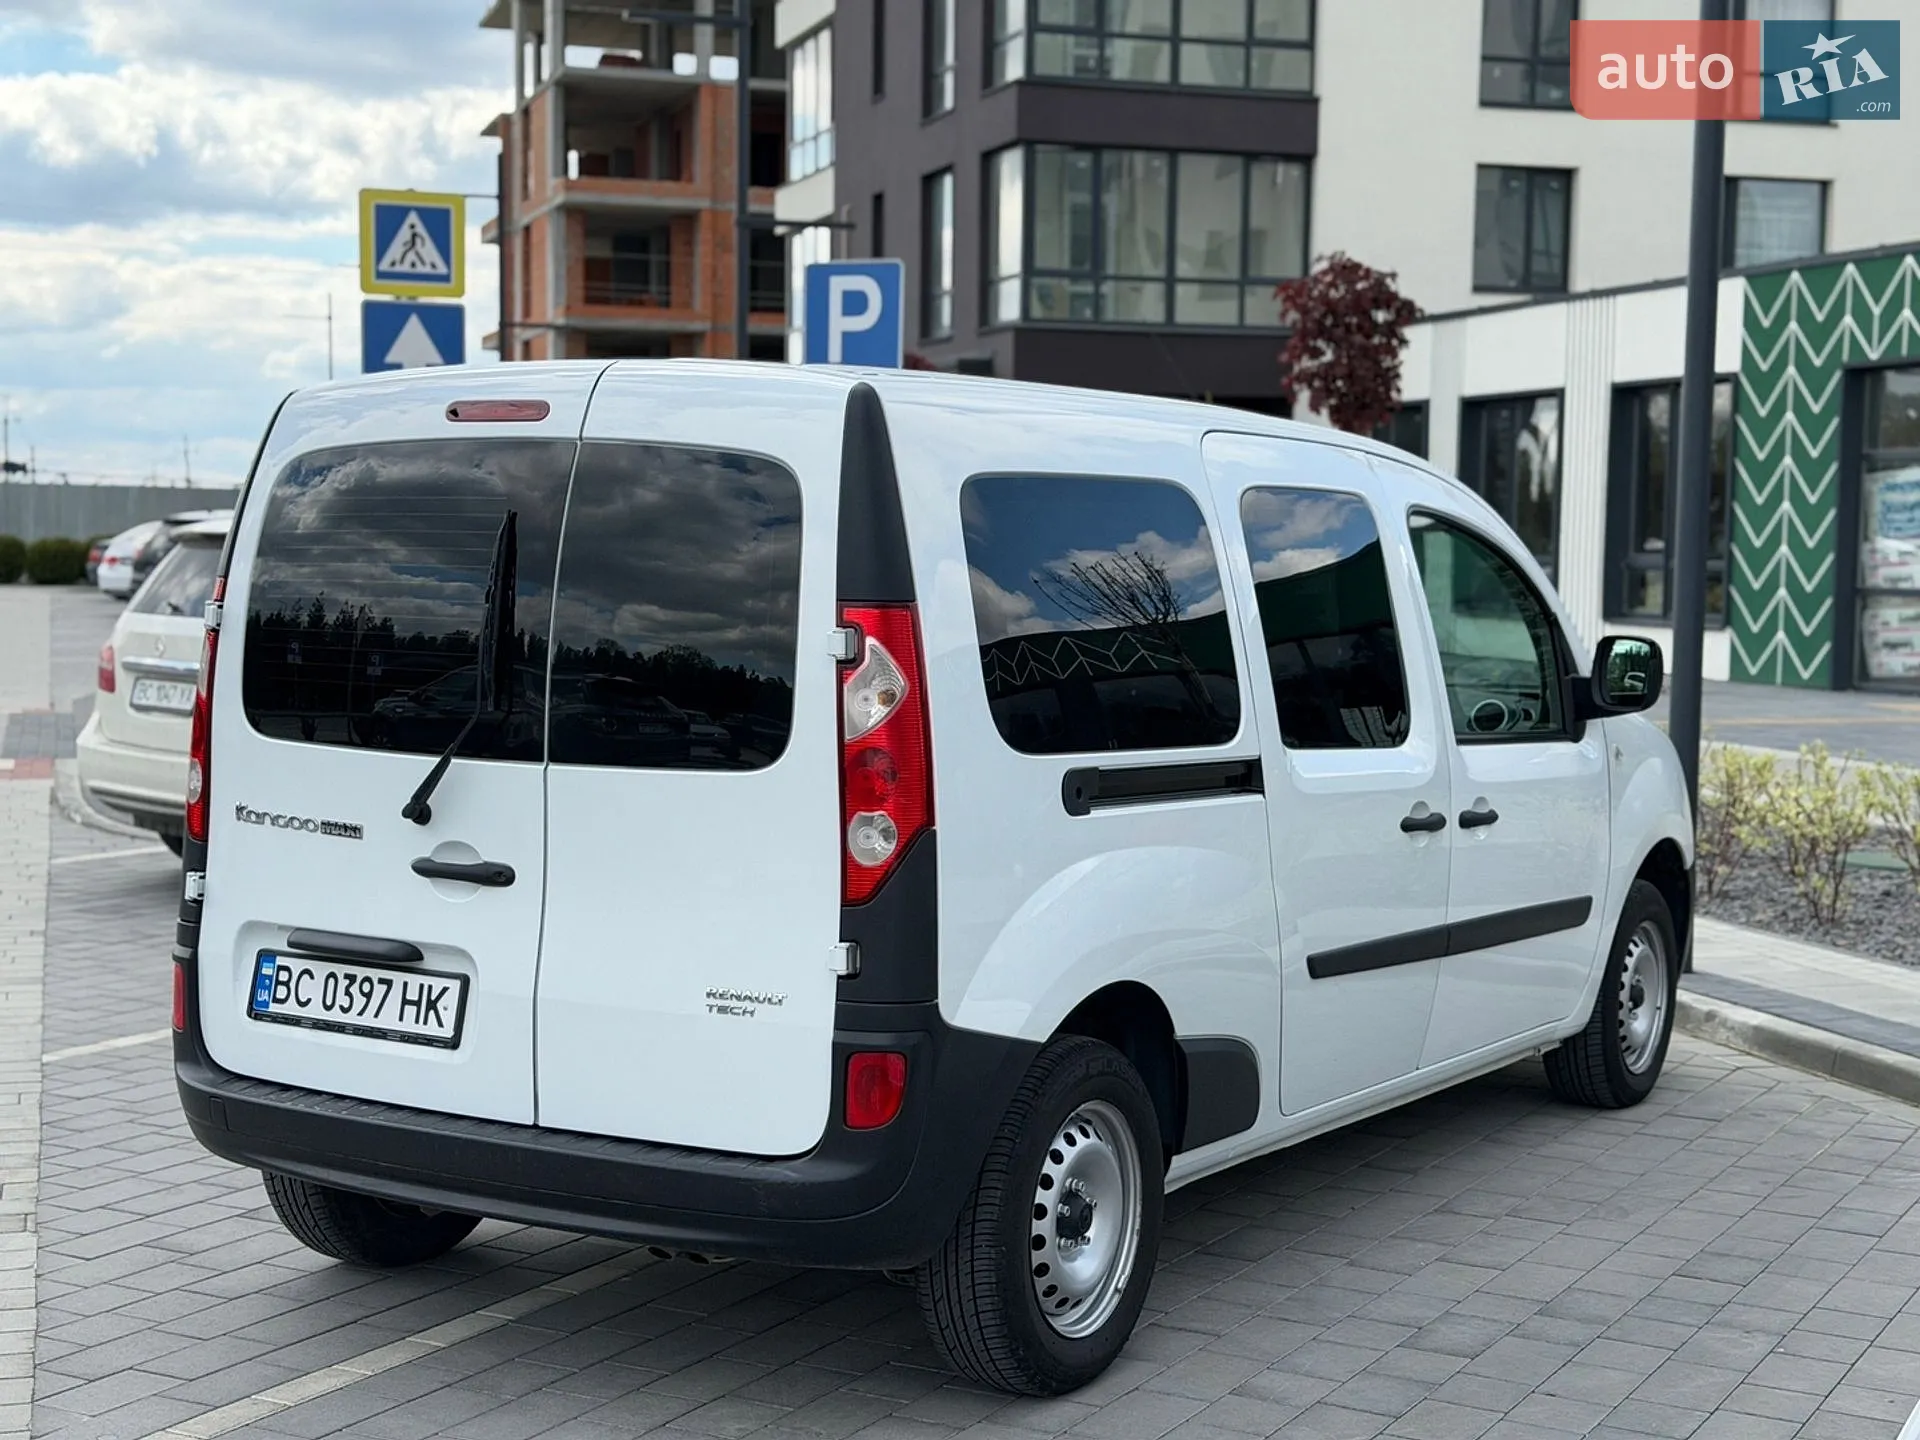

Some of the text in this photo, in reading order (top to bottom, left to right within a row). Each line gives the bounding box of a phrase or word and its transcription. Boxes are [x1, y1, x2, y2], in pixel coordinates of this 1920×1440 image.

[828, 275, 883, 363] P
[235, 801, 319, 833] Kangoo
[257, 989, 270, 1002] UA
[271, 964, 450, 1028] BC 0397 HK
[705, 986, 787, 1006] RENAULT
[706, 1003, 756, 1018] TECH
